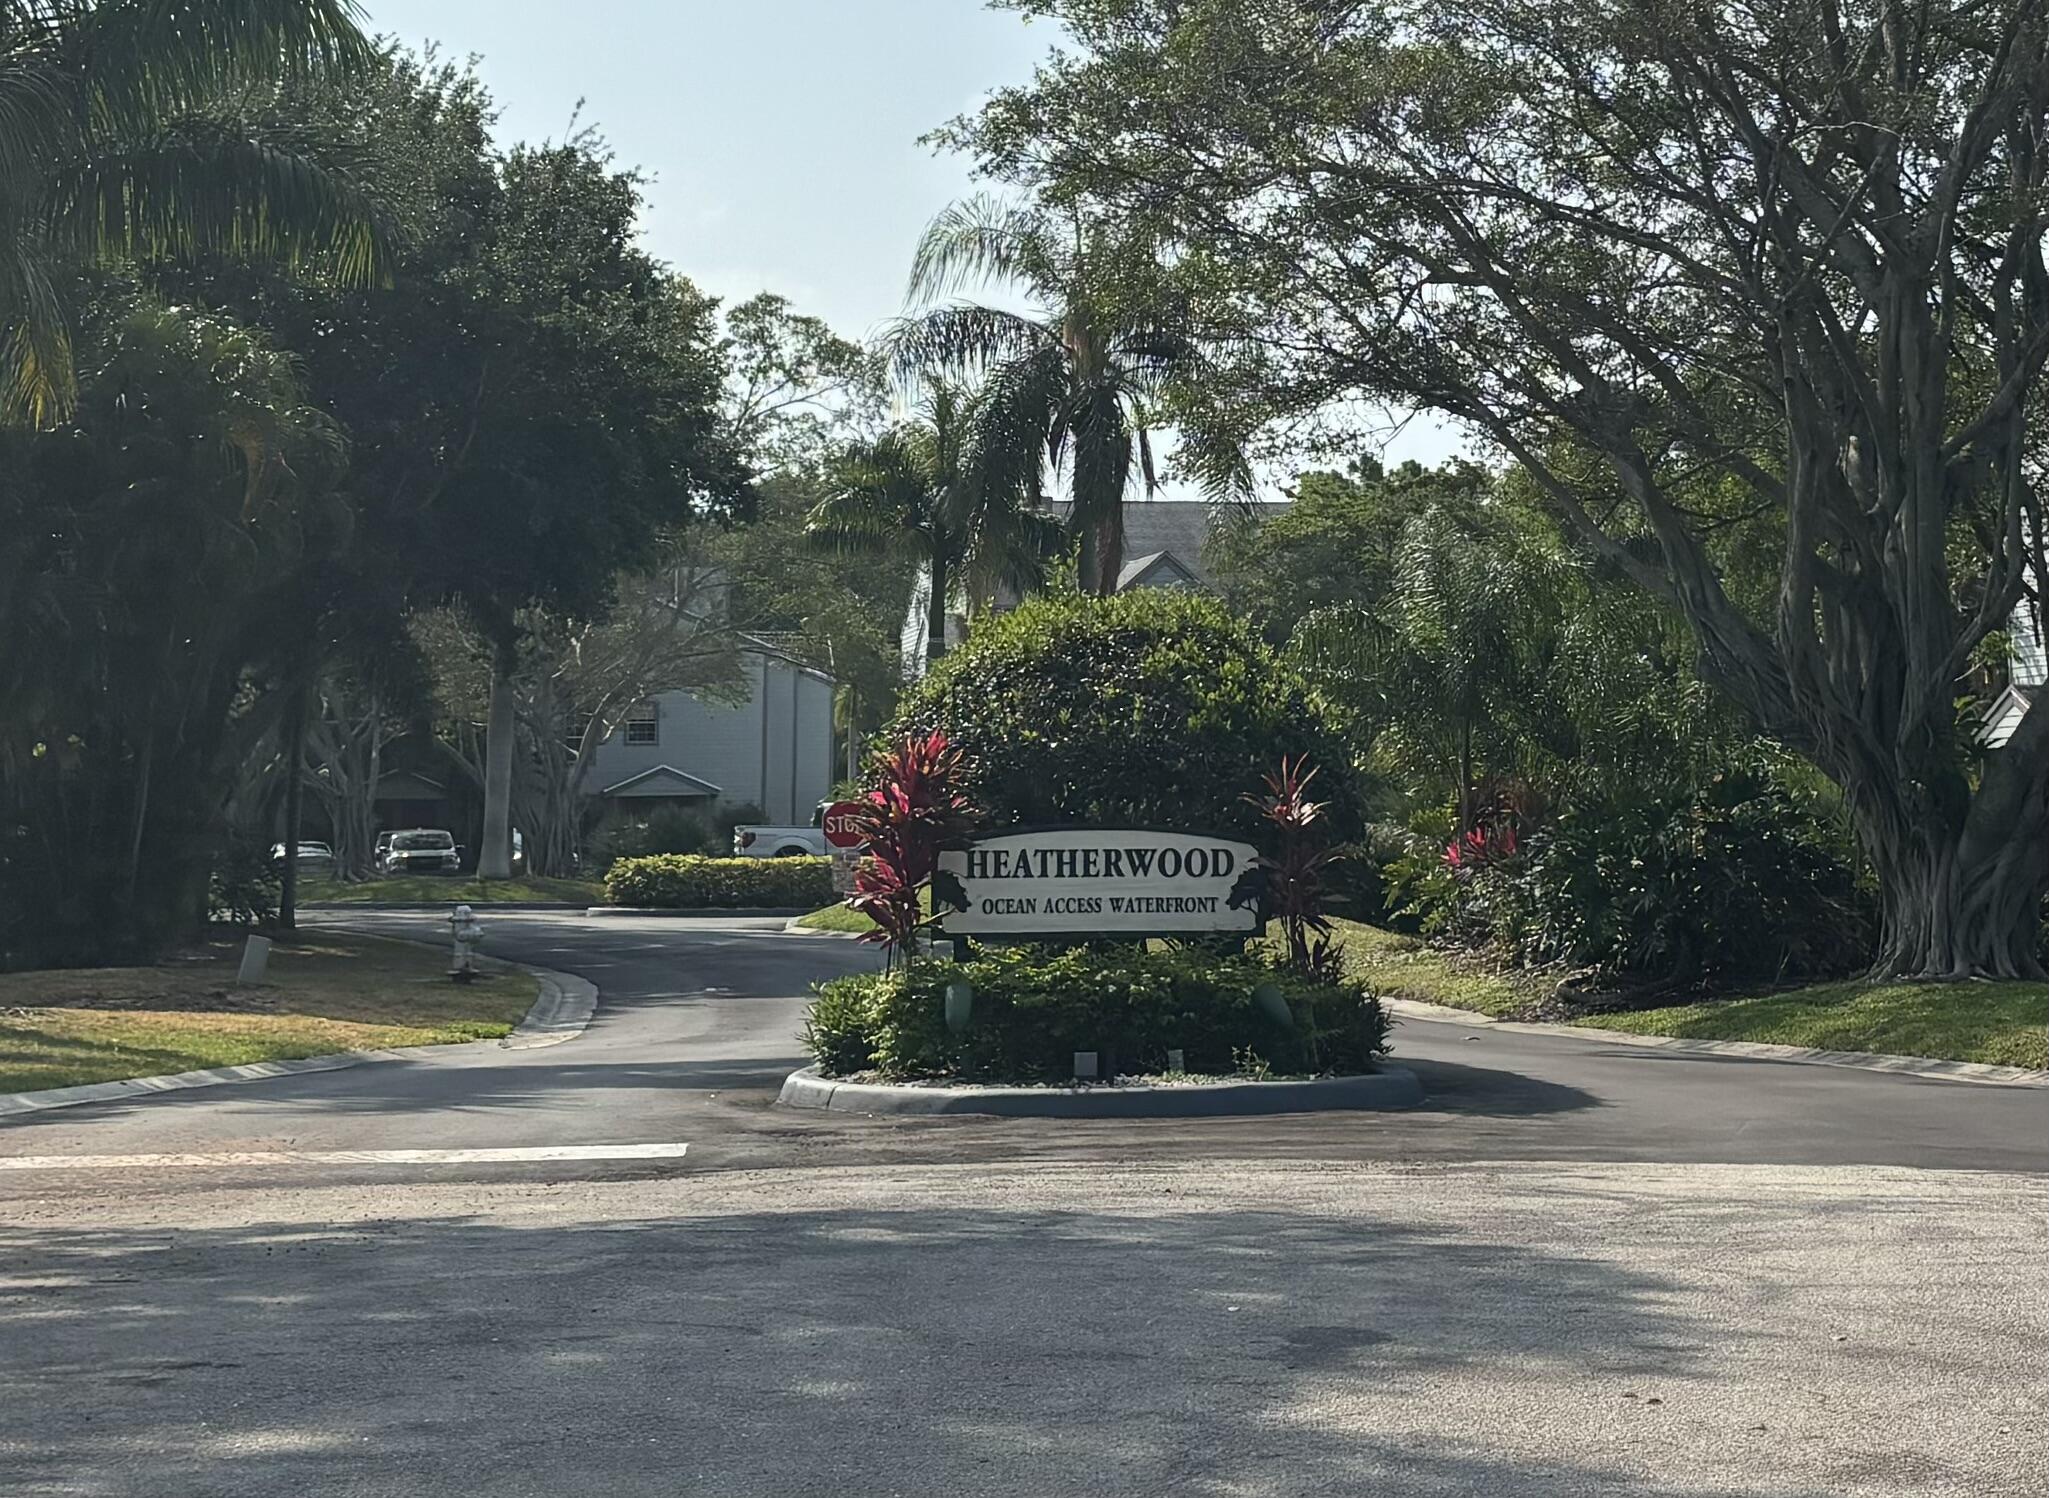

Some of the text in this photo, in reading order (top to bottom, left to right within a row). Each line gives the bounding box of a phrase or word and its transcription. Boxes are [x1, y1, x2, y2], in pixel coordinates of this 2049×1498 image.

[825, 816, 858, 833] STO
[967, 847, 1234, 879] HEATHERWOOD
[982, 896, 1218, 914] OCEAN ACCESS WATERFRONT
